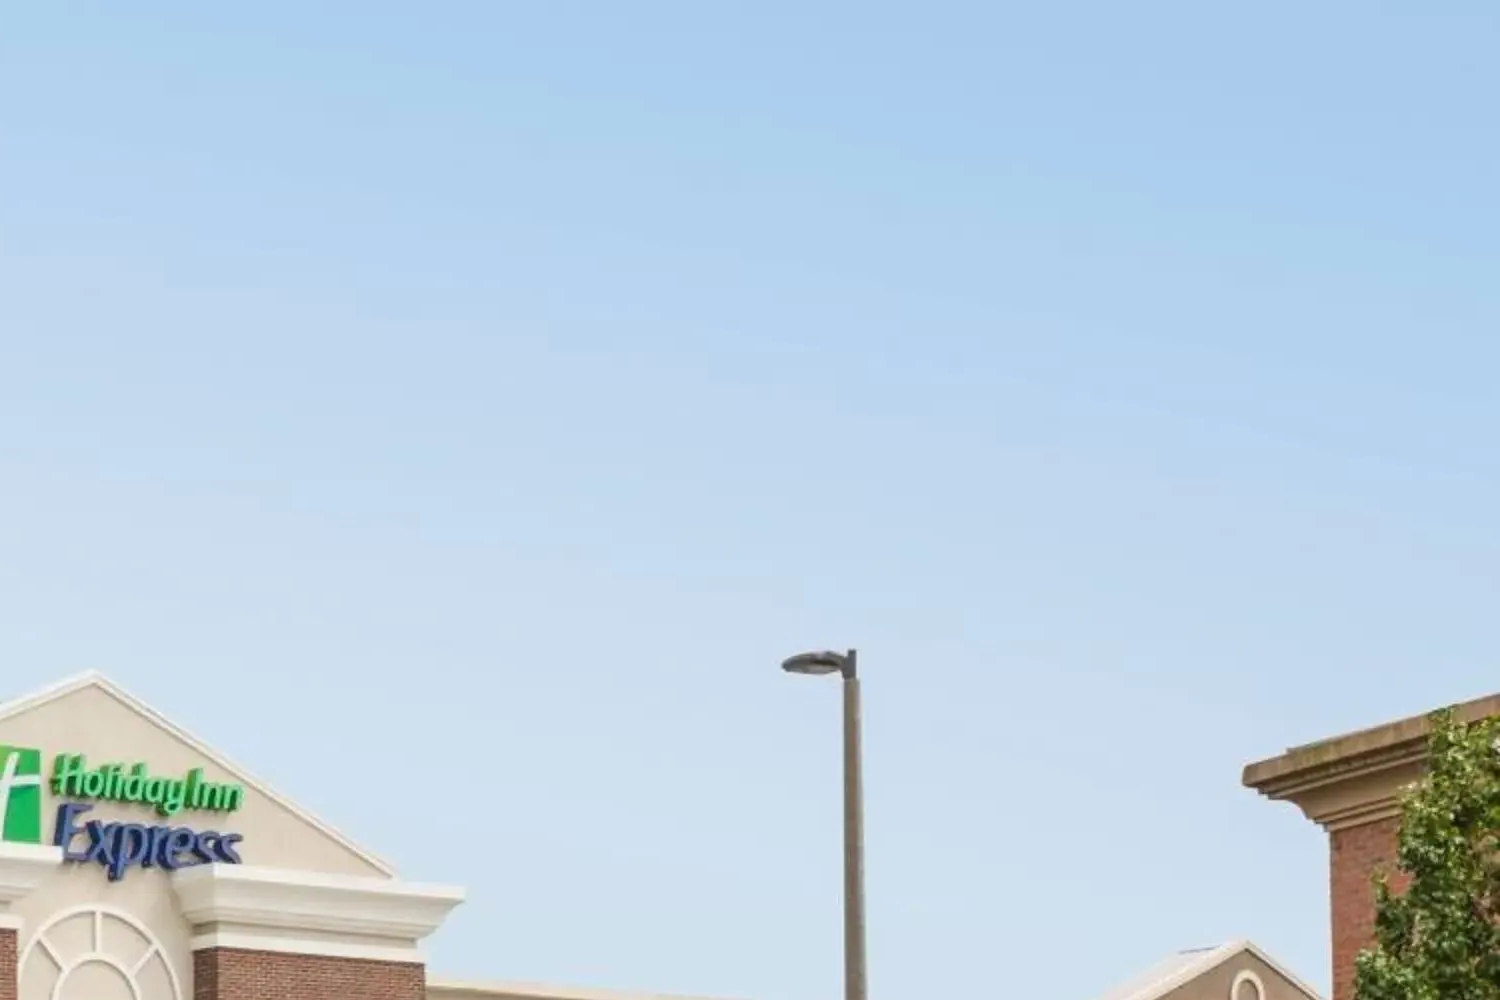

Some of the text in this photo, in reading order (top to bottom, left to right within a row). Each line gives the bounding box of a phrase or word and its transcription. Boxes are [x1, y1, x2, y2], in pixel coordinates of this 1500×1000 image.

[50, 753, 245, 817] Holiday Inn
[54, 803, 244, 882] Express
